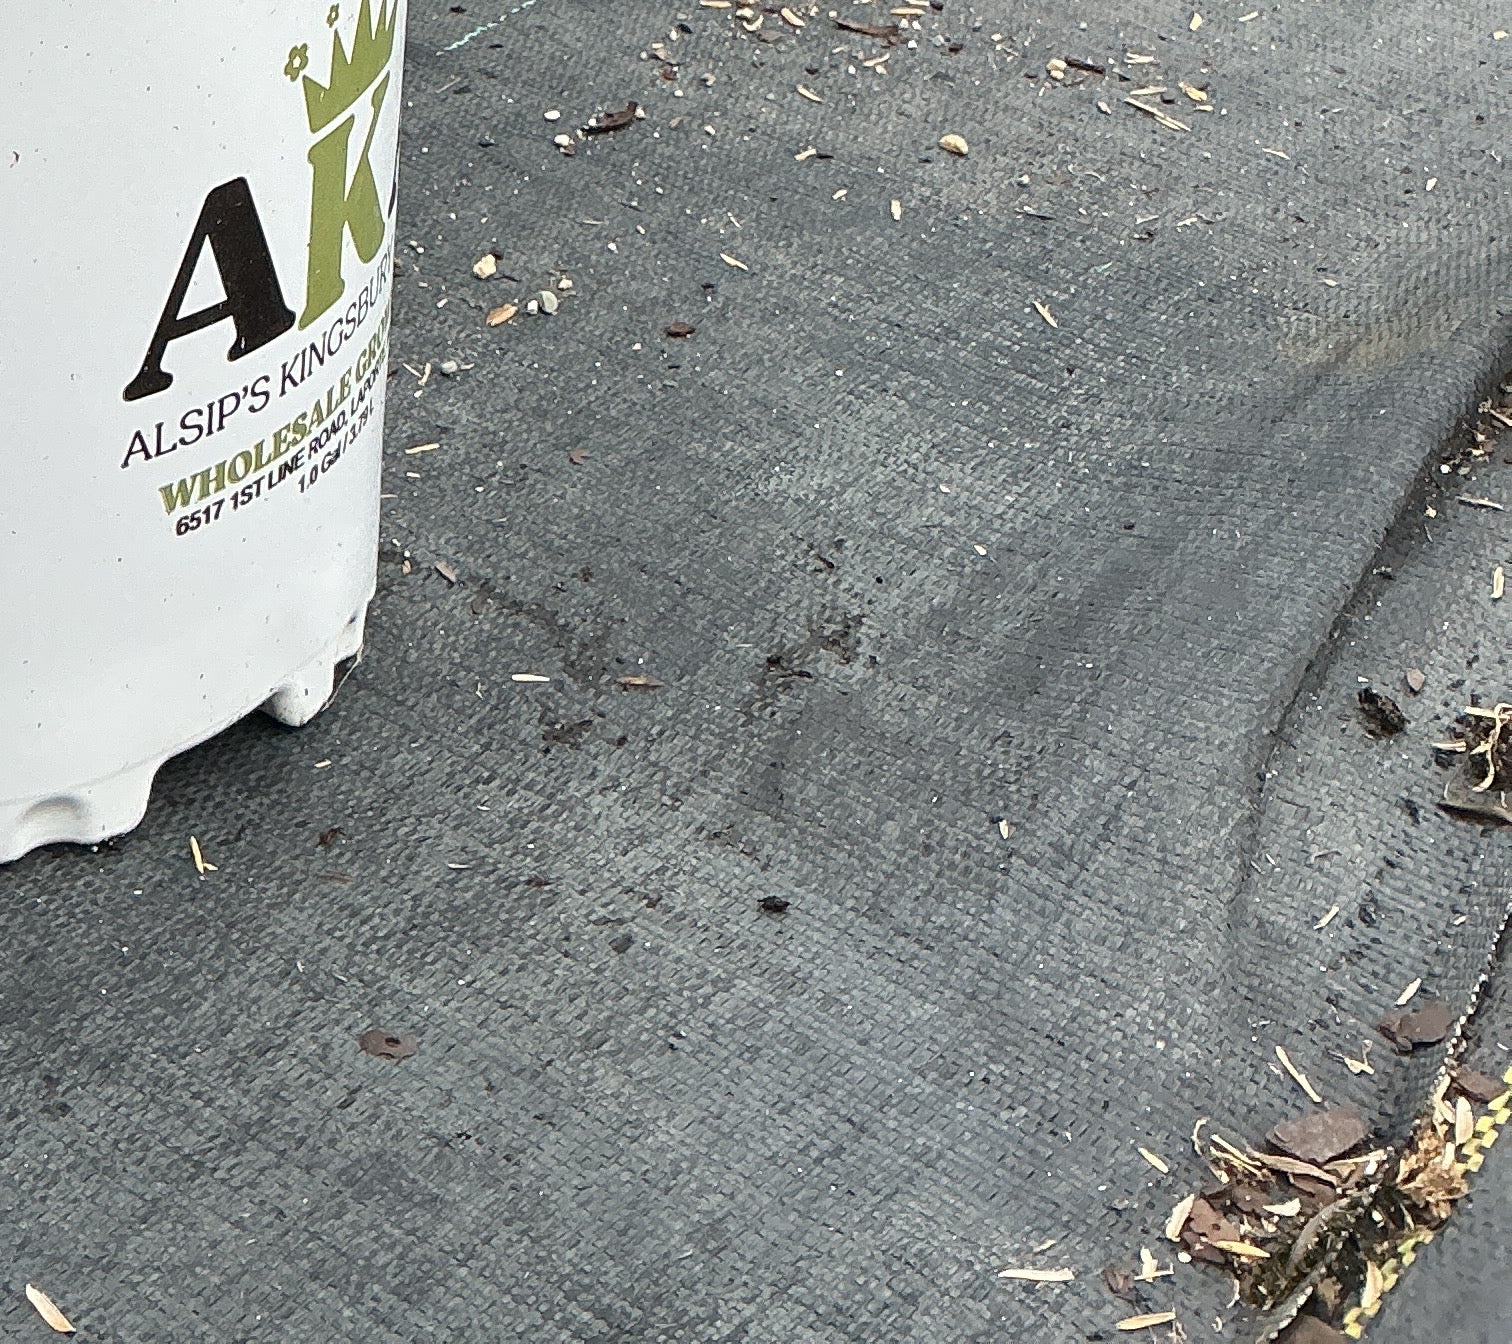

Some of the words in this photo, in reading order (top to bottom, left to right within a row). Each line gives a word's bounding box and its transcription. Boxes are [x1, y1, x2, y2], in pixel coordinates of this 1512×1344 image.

[120, 375, 271, 469] ALSIP'S
[158, 366, 352, 516] WHOLESALE
[175, 498, 225, 537] 6517
[230, 474, 266, 512] 1ST
[267, 446, 306, 491] LINE
[307, 409, 349, 460] ROAD,
[297, 467, 319, 494] 1.0
